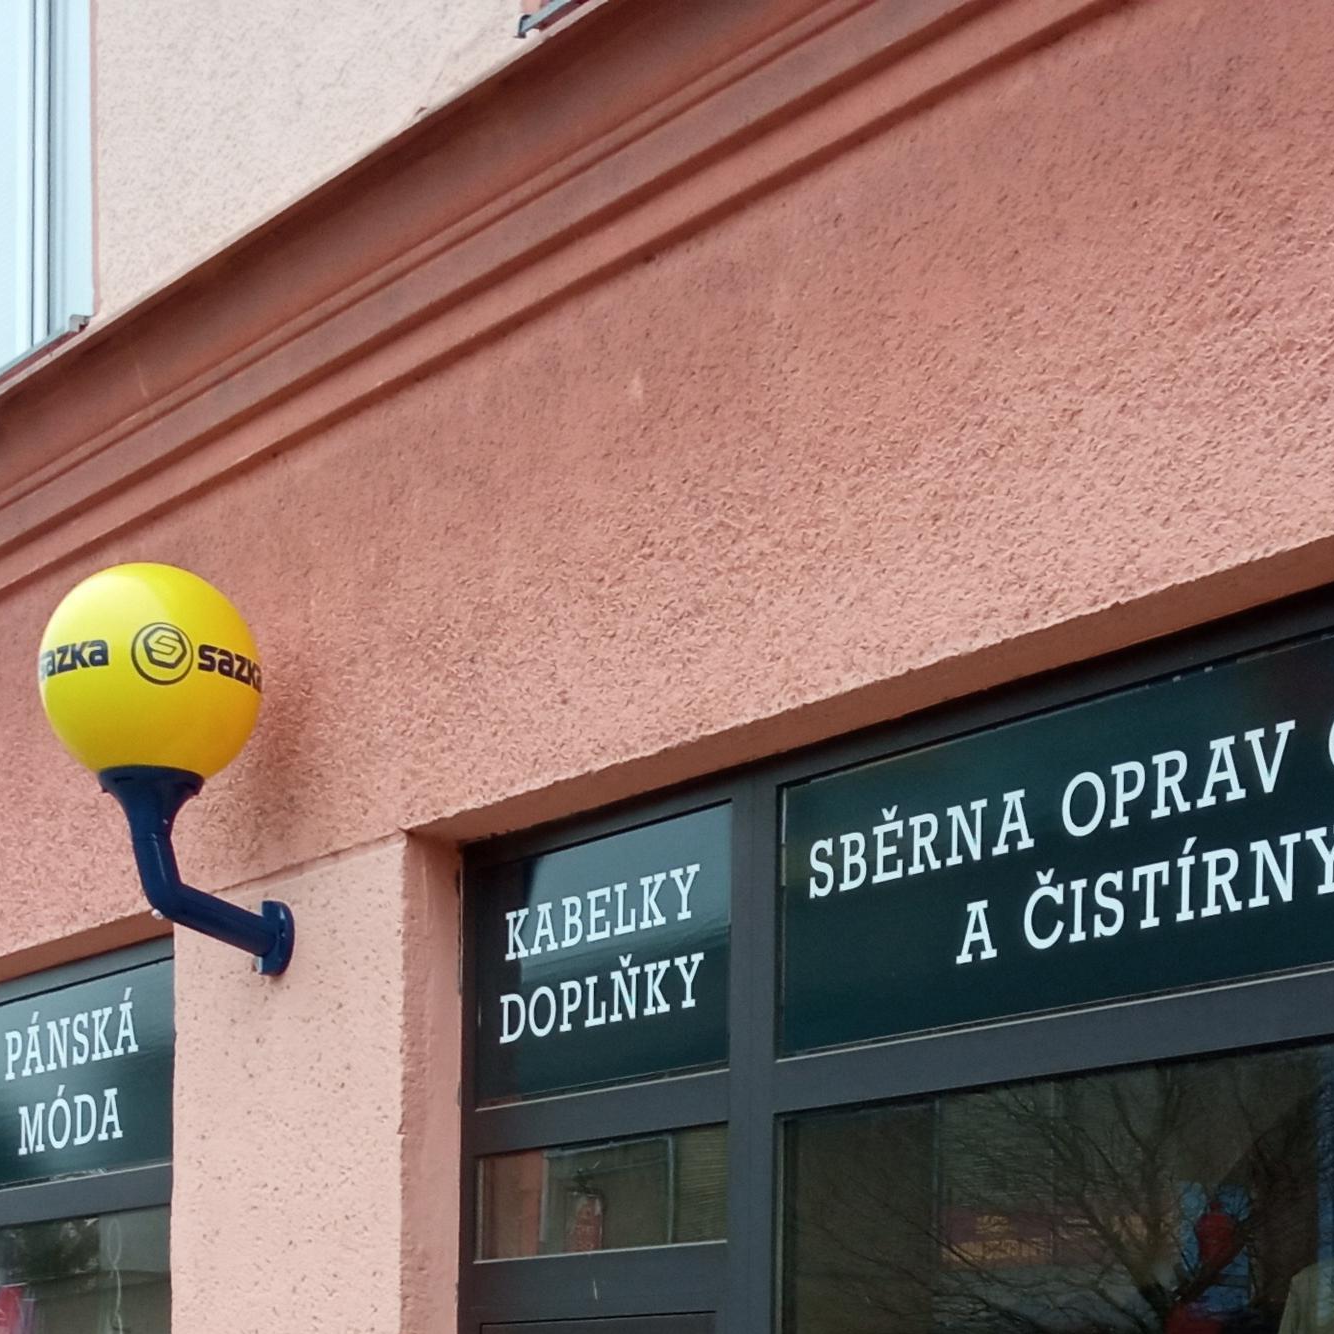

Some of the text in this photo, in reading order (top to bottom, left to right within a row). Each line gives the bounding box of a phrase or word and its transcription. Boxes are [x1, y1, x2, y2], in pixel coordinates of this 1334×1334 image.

[808, 788, 1036, 900] SBĚRNA
[1061, 720, 1296, 838] OPRAV
[505, 863, 701, 961] KABELKY
[955, 898, 998, 965] A
[4, 987, 140, 1082] PÁNSKÁ
[499, 952, 704, 1044] DOPLŇKY
[17, 1084, 124, 1156] MÓDA
